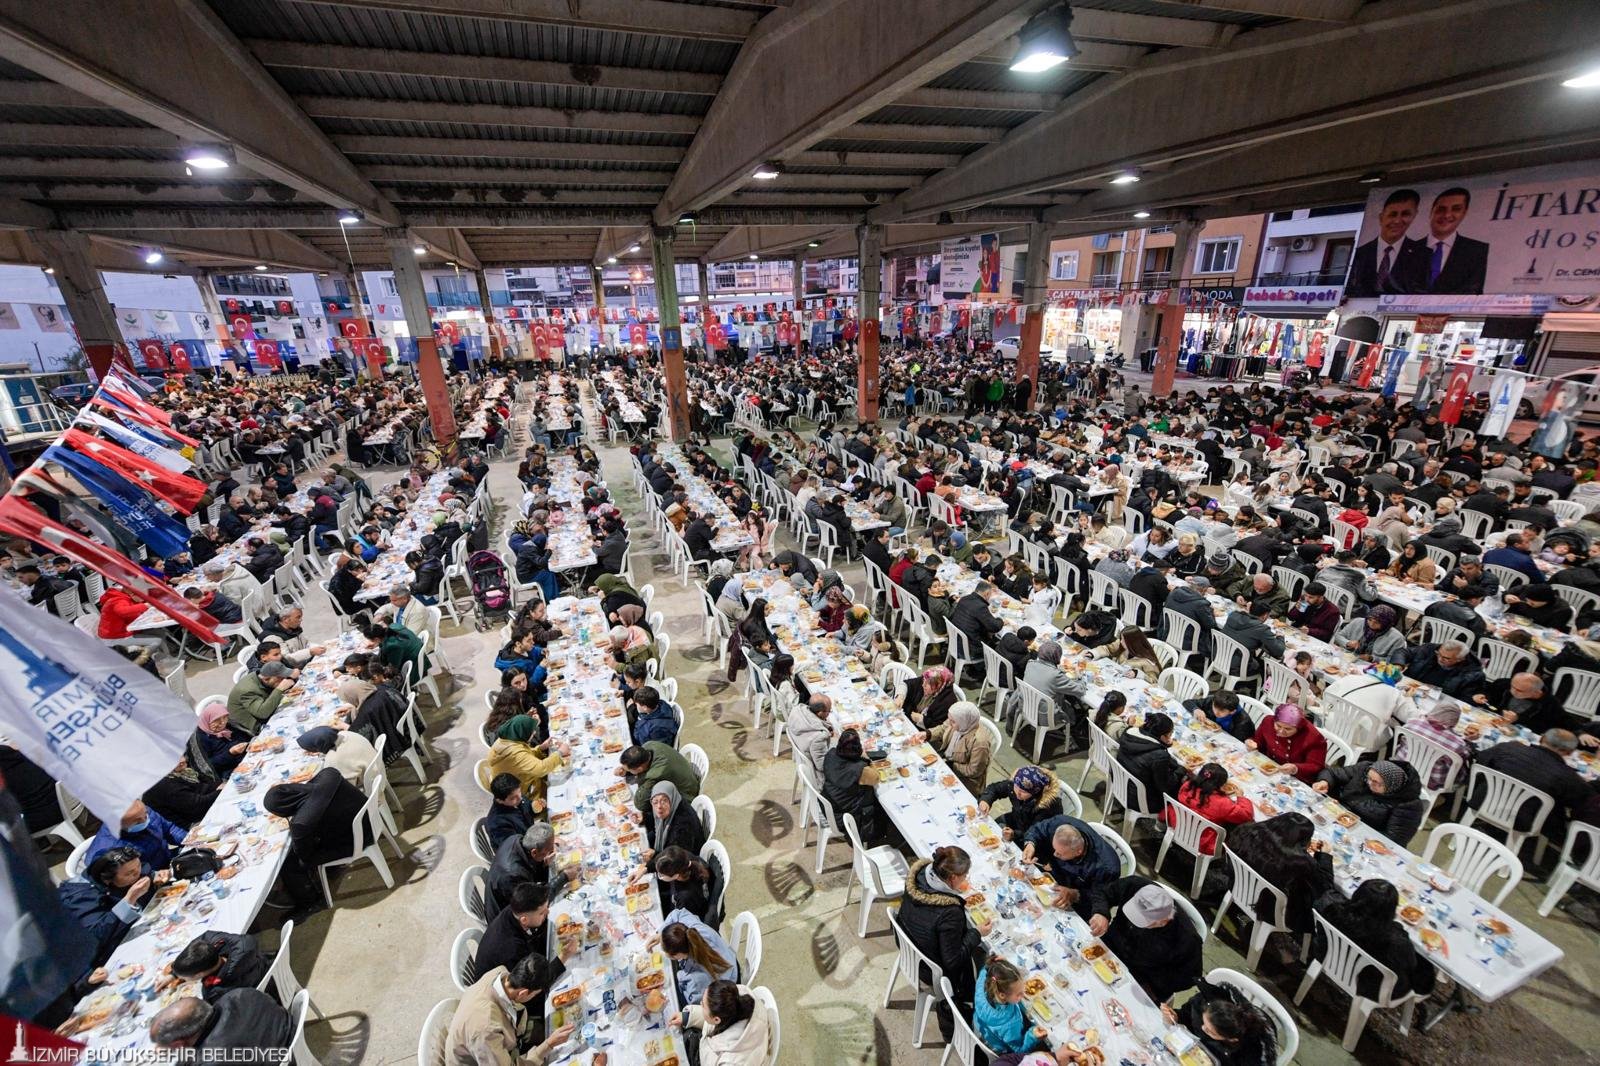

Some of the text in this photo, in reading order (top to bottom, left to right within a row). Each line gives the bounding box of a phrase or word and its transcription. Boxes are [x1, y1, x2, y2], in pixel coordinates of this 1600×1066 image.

[1489, 182, 1600, 221] İFTAR
[1245, 288, 1338, 304] bebek sepeti
